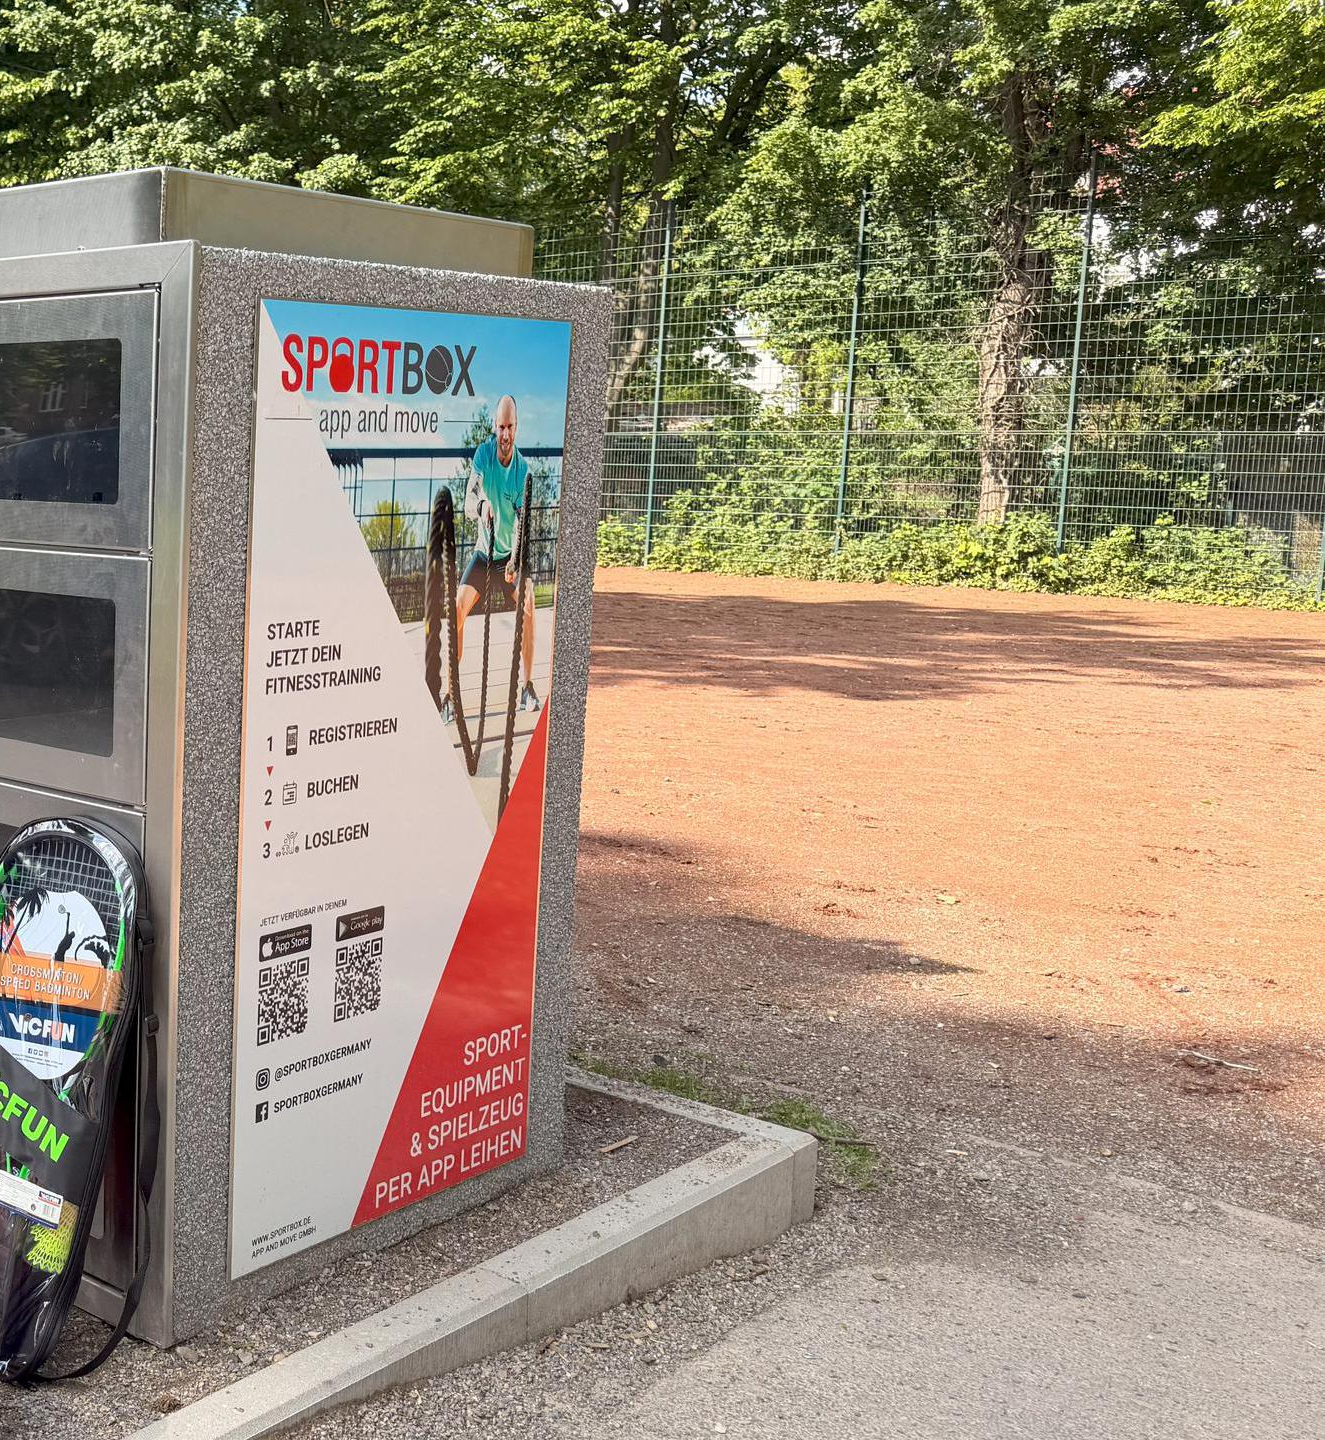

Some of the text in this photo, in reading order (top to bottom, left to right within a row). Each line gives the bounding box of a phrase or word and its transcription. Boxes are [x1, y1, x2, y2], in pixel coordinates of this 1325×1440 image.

[281, 333, 477, 397] SPORTBOX
[319, 404, 438, 439] app and move
[267, 619, 320, 641] STARTE
[266, 644, 342, 668] JETZT DEIN
[265, 665, 381, 695] FITNESSTRAINING
[266, 717, 398, 752] 1 REGISTRIEREN
[264, 774, 359, 806] 2 BUCHEN
[262, 822, 369, 859] 3 LOSLEGEN
[260, 899, 348, 927] JETZT VERFÜGBAR IN DEINEM
[275, 936, 309, 954] App Store
[0, 975, 90, 1000] SPEED BADMINTON
[274, 1038, 372, 1081] @SPORTBOXGERMANY
[463, 1023, 527, 1066] SPORT-
[273, 1073, 364, 1113] SPORTBOXGERMANY
[420, 1057, 526, 1118] EQUIPMENT
[410, 1092, 524, 1157] & SPIELZEUG
[375, 1126, 522, 1209] PER APP LEIHEN
[251, 1215, 312, 1247] WWW.SPORTBOX.DE
[251, 1226, 317, 1259] APP AND MOVE GMBH
